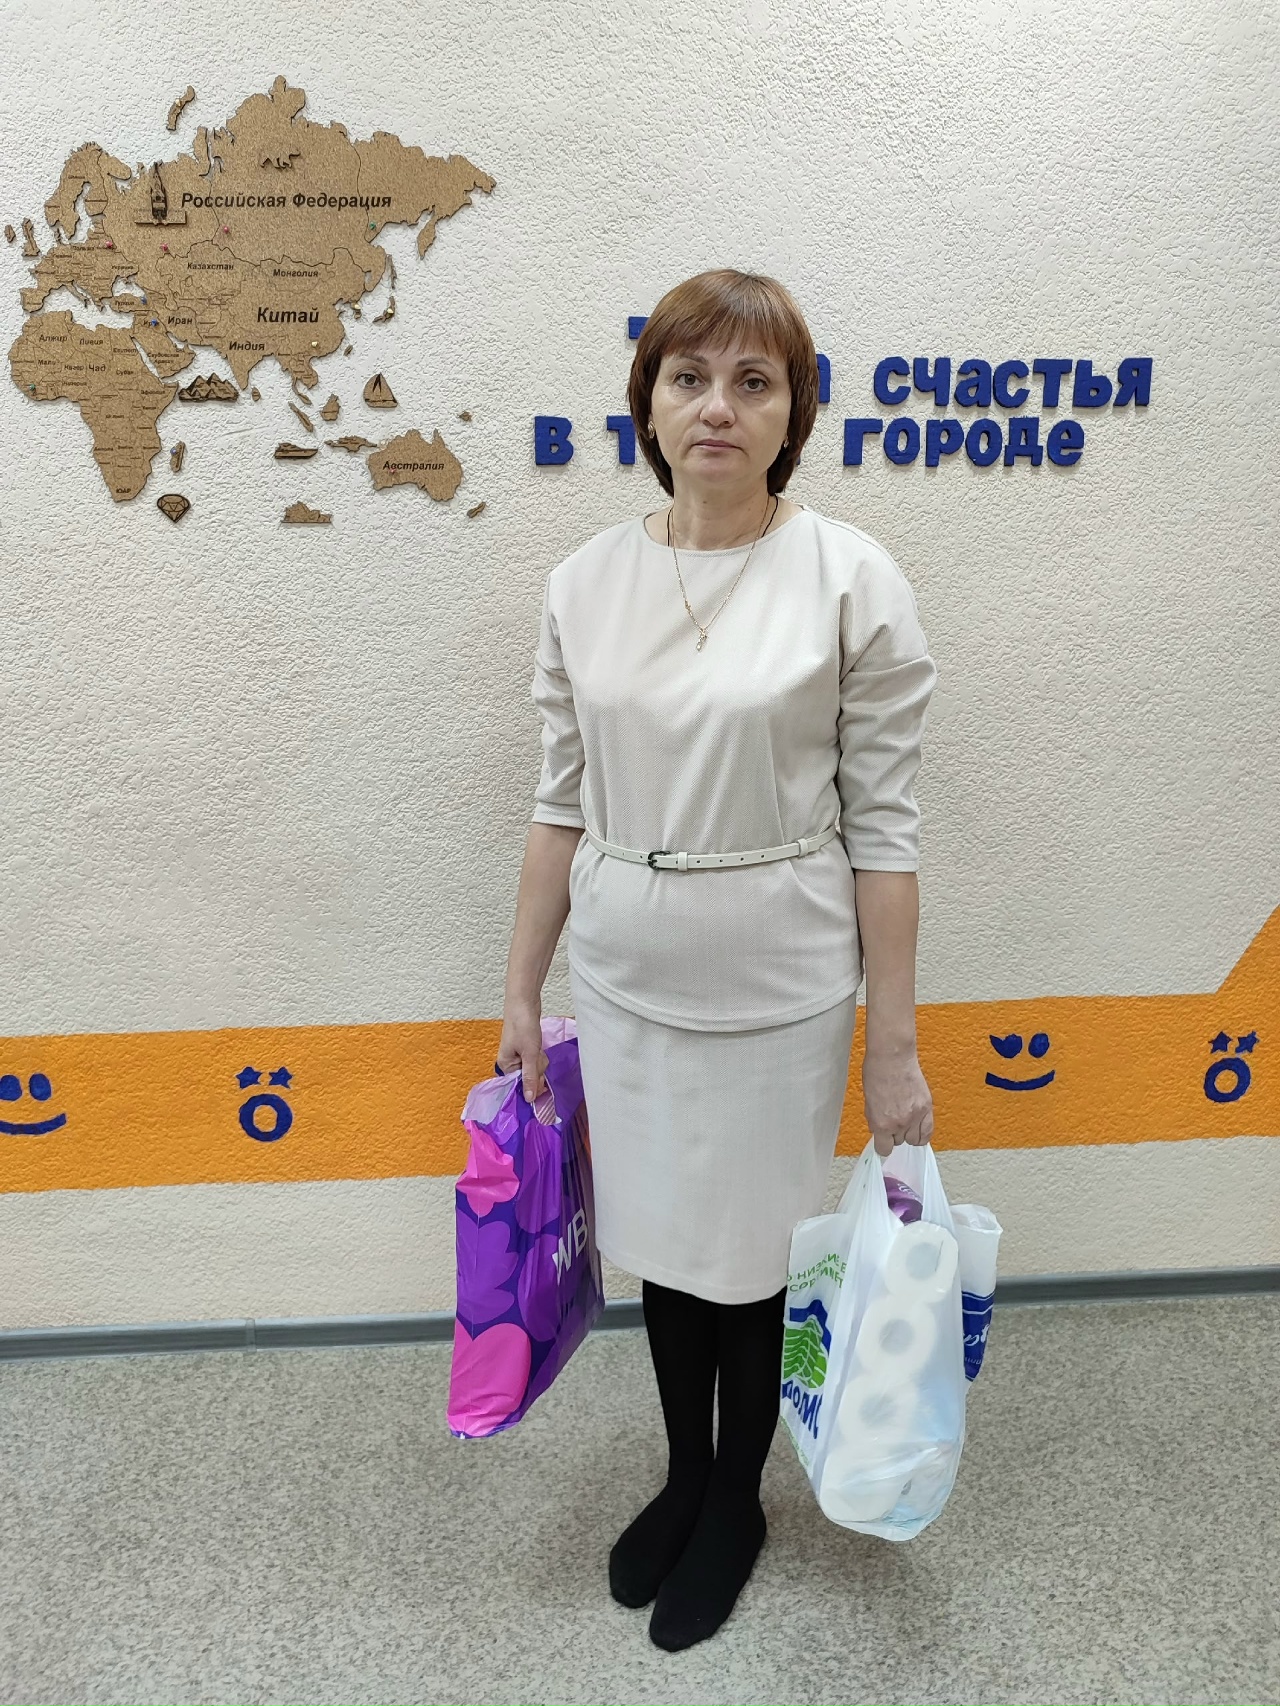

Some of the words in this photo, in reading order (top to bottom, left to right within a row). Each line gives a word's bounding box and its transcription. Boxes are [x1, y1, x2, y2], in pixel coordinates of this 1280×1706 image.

[181, 193, 286, 208] Российская
[292, 193, 392, 210] Федерация
[187, 262, 234, 270] Казахстан
[273, 269, 319, 277] Монголия
[257, 307, 320, 323] Китай
[167, 316, 193, 326] Иран
[39, 334, 68, 343] Алжир
[79, 338, 104, 346] Ливия
[229, 341, 265, 351] Индия
[88, 363, 106, 372] Чад
[873, 356, 1153, 408] счастья
[842, 417, 1085, 467] городе
[382, 460, 445, 472] Австралия
[551, 1208, 588, 1287] WB
